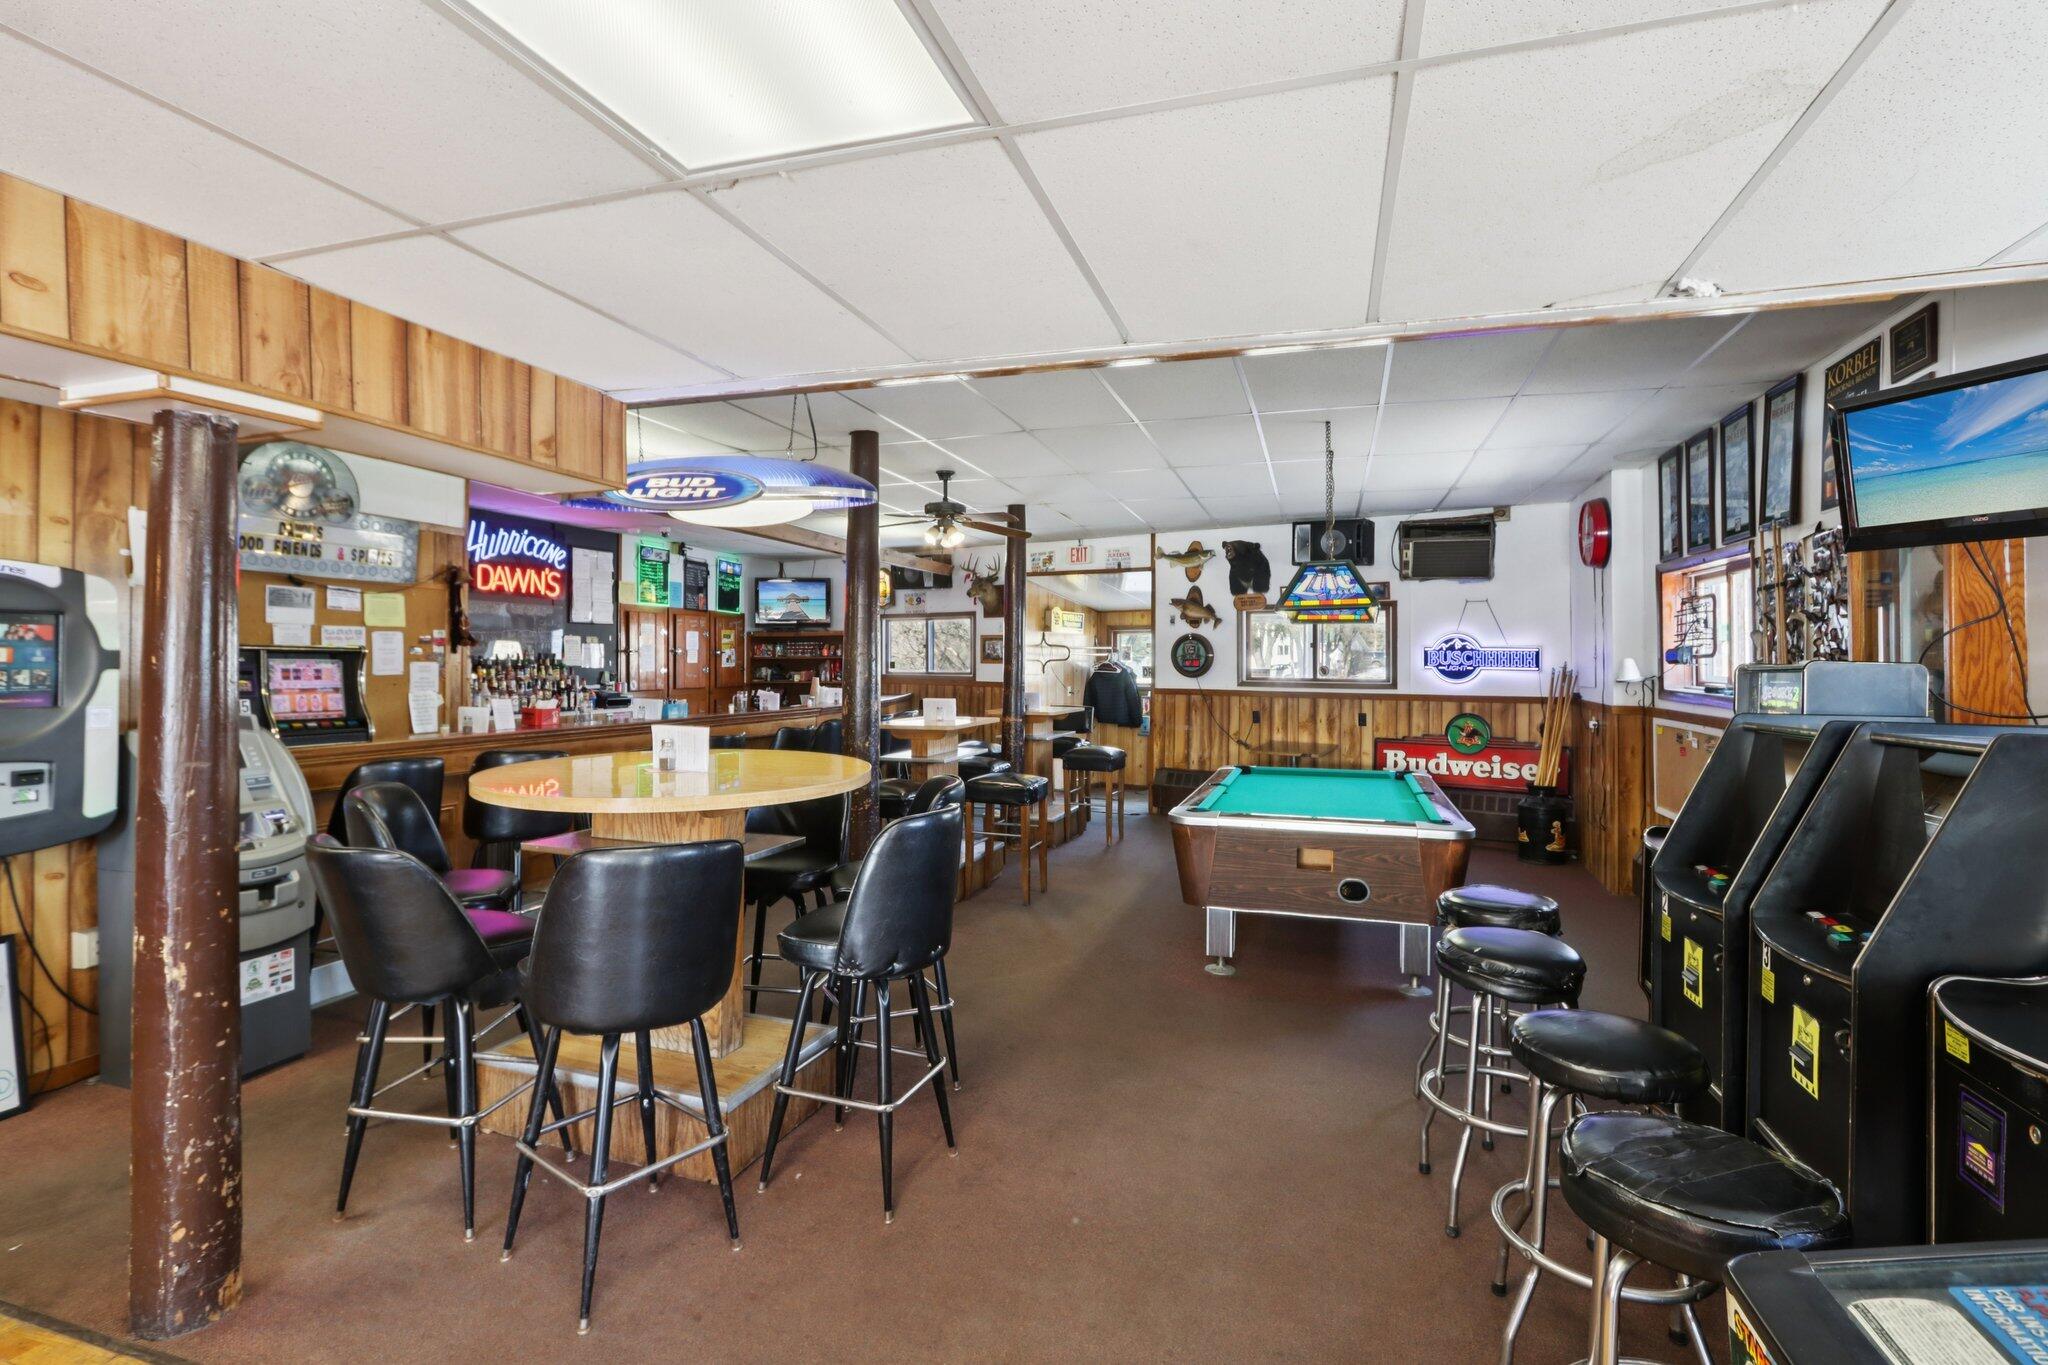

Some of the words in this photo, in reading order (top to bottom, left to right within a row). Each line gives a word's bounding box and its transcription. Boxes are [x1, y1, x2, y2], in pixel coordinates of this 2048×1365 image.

[1827, 344, 1877, 391] KORBEL
[645, 477, 716, 488] BUD
[632, 487, 726, 499] LIGHT
[274, 539, 322, 558] FRIENDS
[467, 520, 567, 570] Hurricane
[1070, 547, 1088, 563] EXIT
[476, 563, 561, 598] DAWN'S
[1427, 650, 1537, 668] BUSCHHHHH
[241, 700, 249, 713] 5
[1382, 749, 1560, 782] Budweise
